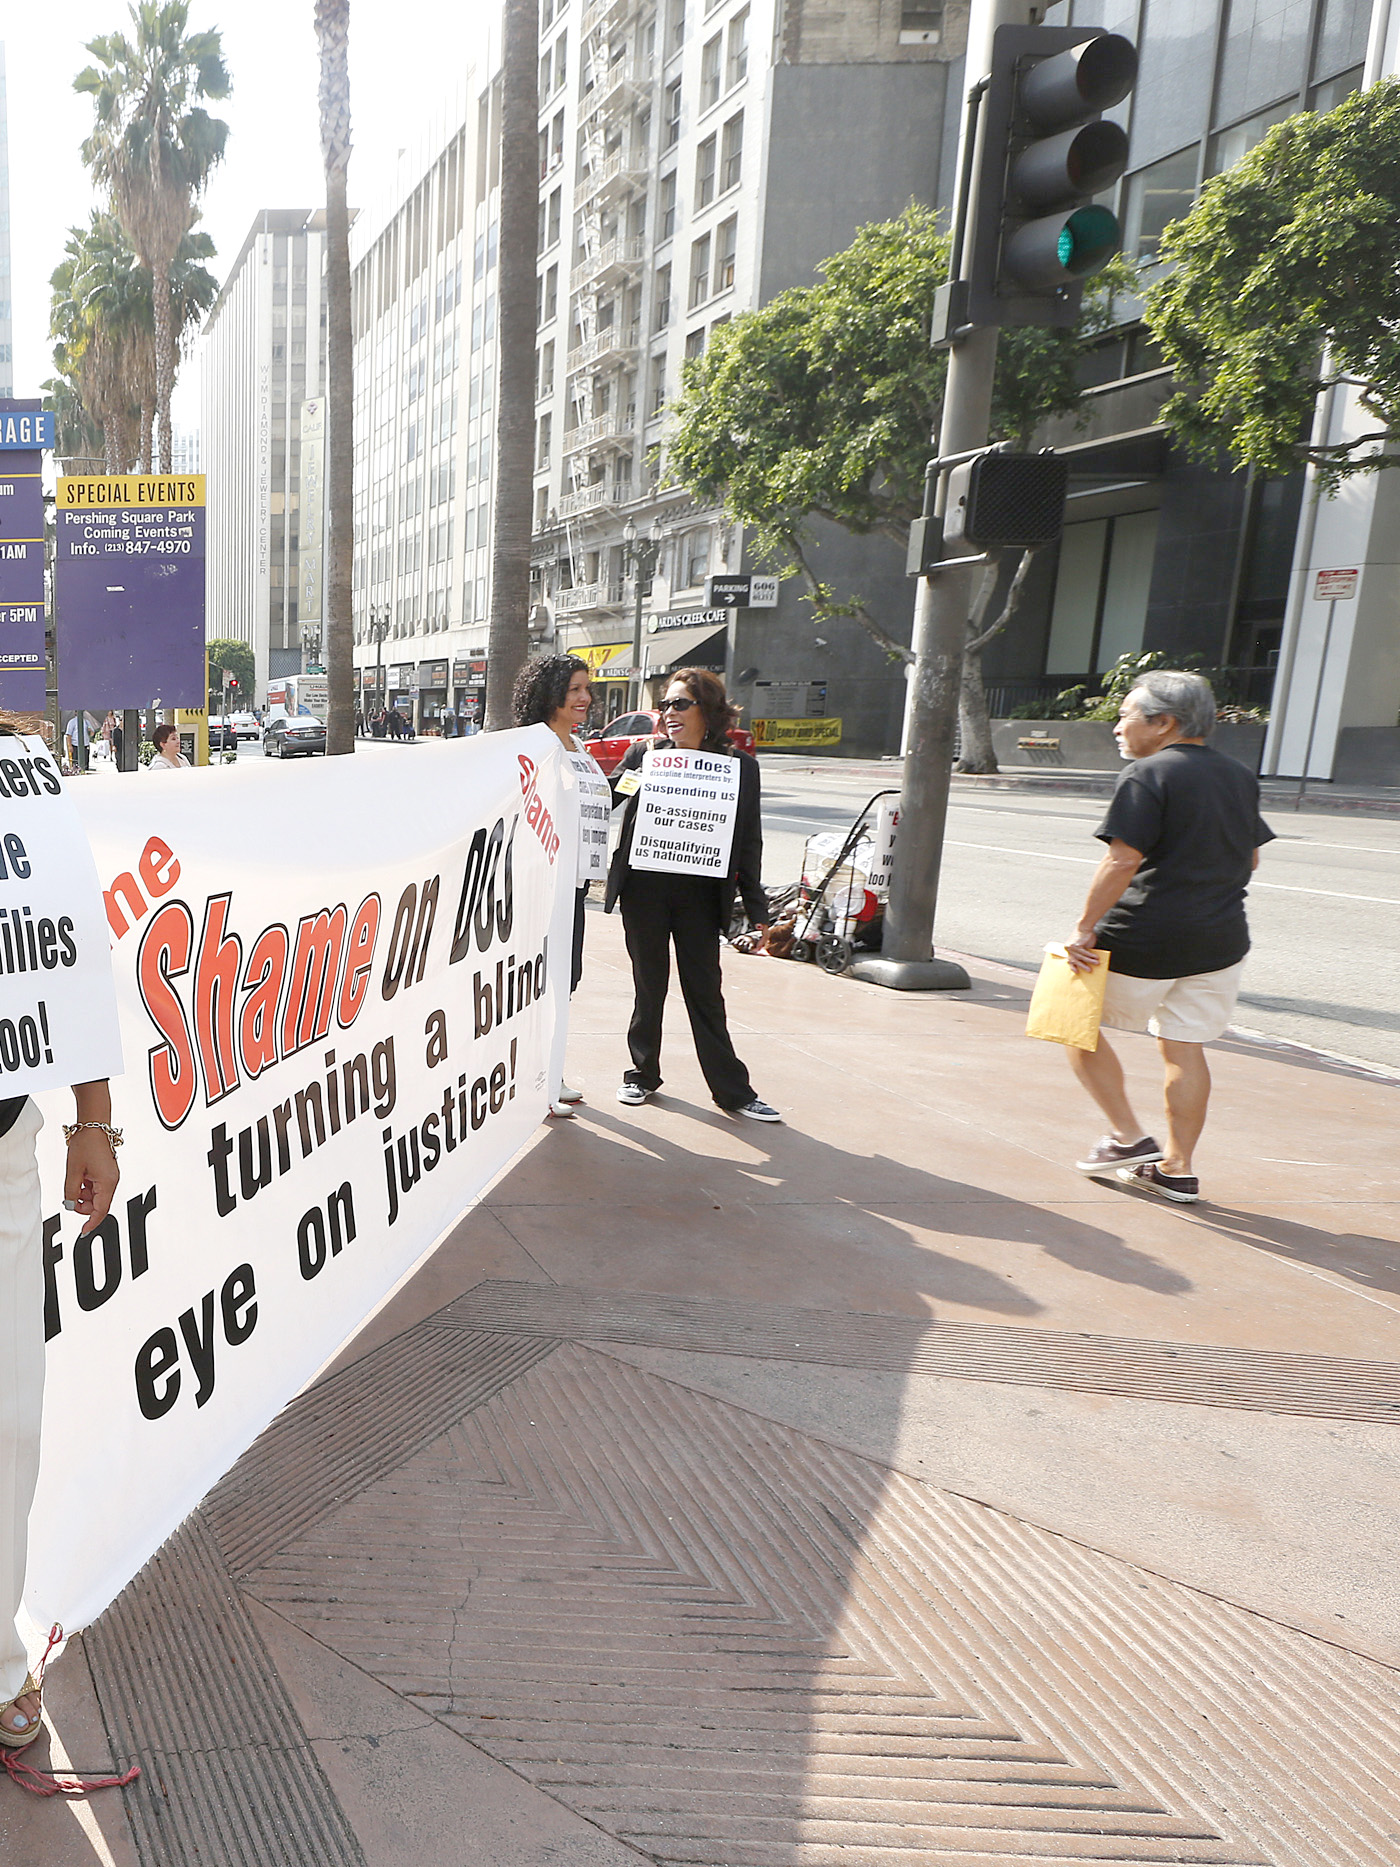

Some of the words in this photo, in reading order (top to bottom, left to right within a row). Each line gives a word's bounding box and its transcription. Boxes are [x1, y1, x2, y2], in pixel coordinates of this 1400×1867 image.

[260, 396, 269, 453] DIAMOND
[260, 456, 268, 464] &
[67, 483, 131, 504] SPECIAL
[138, 481, 195, 502] EVENTS
[259, 469, 269, 524] JEWELRY
[65, 512, 117, 525] Pershing
[121, 511, 164, 525] Square
[168, 510, 196, 523] Park
[83, 526, 130, 540] Coming
[135, 526, 178, 538] Events
[70, 542, 100, 555] Info.
[259, 528, 268, 575] CENTER
[303, 557, 317, 613] MART
[713, 584, 749, 593] PARKING
[753, 582, 775, 591] 606
[9, 607, 37, 622] 5PM
[682, 612, 706, 626] GREEK
[706, 609, 726, 623] CAFE
[650, 769, 682, 778] discipline
[683, 771, 722, 782] interpreters
[694, 758, 732, 774] does
[644, 782, 717, 800] Suspending
[720, 792, 736, 802] us
[645, 802, 727, 824] De-assigning
[654, 816, 675, 828] our
[678, 819, 715, 833] cases
[640, 835, 721, 858] Disqualifying
[635, 847, 649, 858] us
[652, 849, 722, 868] nationwide
[136, 889, 383, 1131] Shame
[381, 874, 440, 1001] on
[449, 813, 519, 966] DOJ
[42, 1183, 157, 1343] for
[207, 1035, 395, 1218] turning
[424, 1008, 448, 1069] a
[473, 934, 548, 1040] blind
[134, 1262, 258, 1421] eye
[296, 1180, 355, 1281] on
[382, 1039, 519, 1228] justice!
